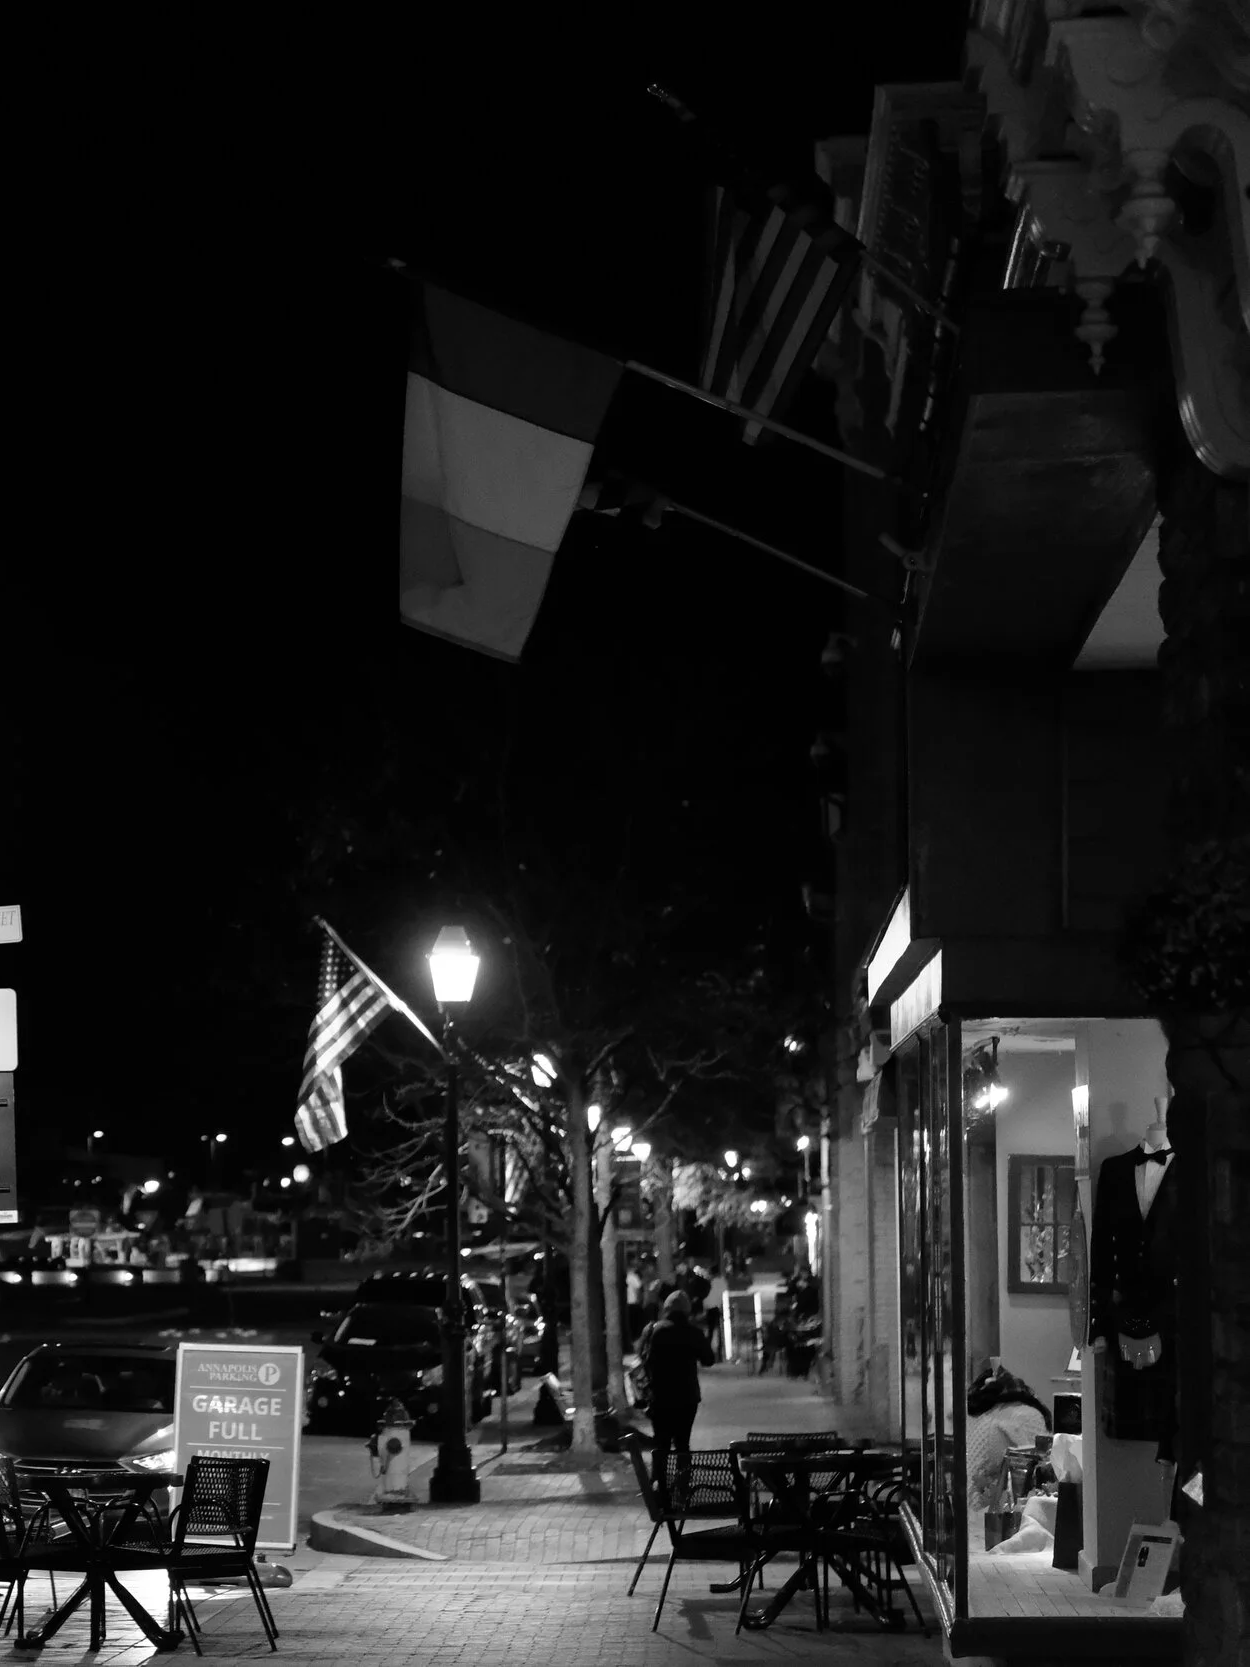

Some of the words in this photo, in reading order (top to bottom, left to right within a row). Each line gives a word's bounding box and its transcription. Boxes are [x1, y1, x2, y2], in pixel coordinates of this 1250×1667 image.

[197, 1363, 257, 1373] ANNAPOLIS
[209, 1372, 257, 1382] PARKING
[192, 1394, 282, 1416] GARAGE
[208, 1420, 263, 1441] FULL
